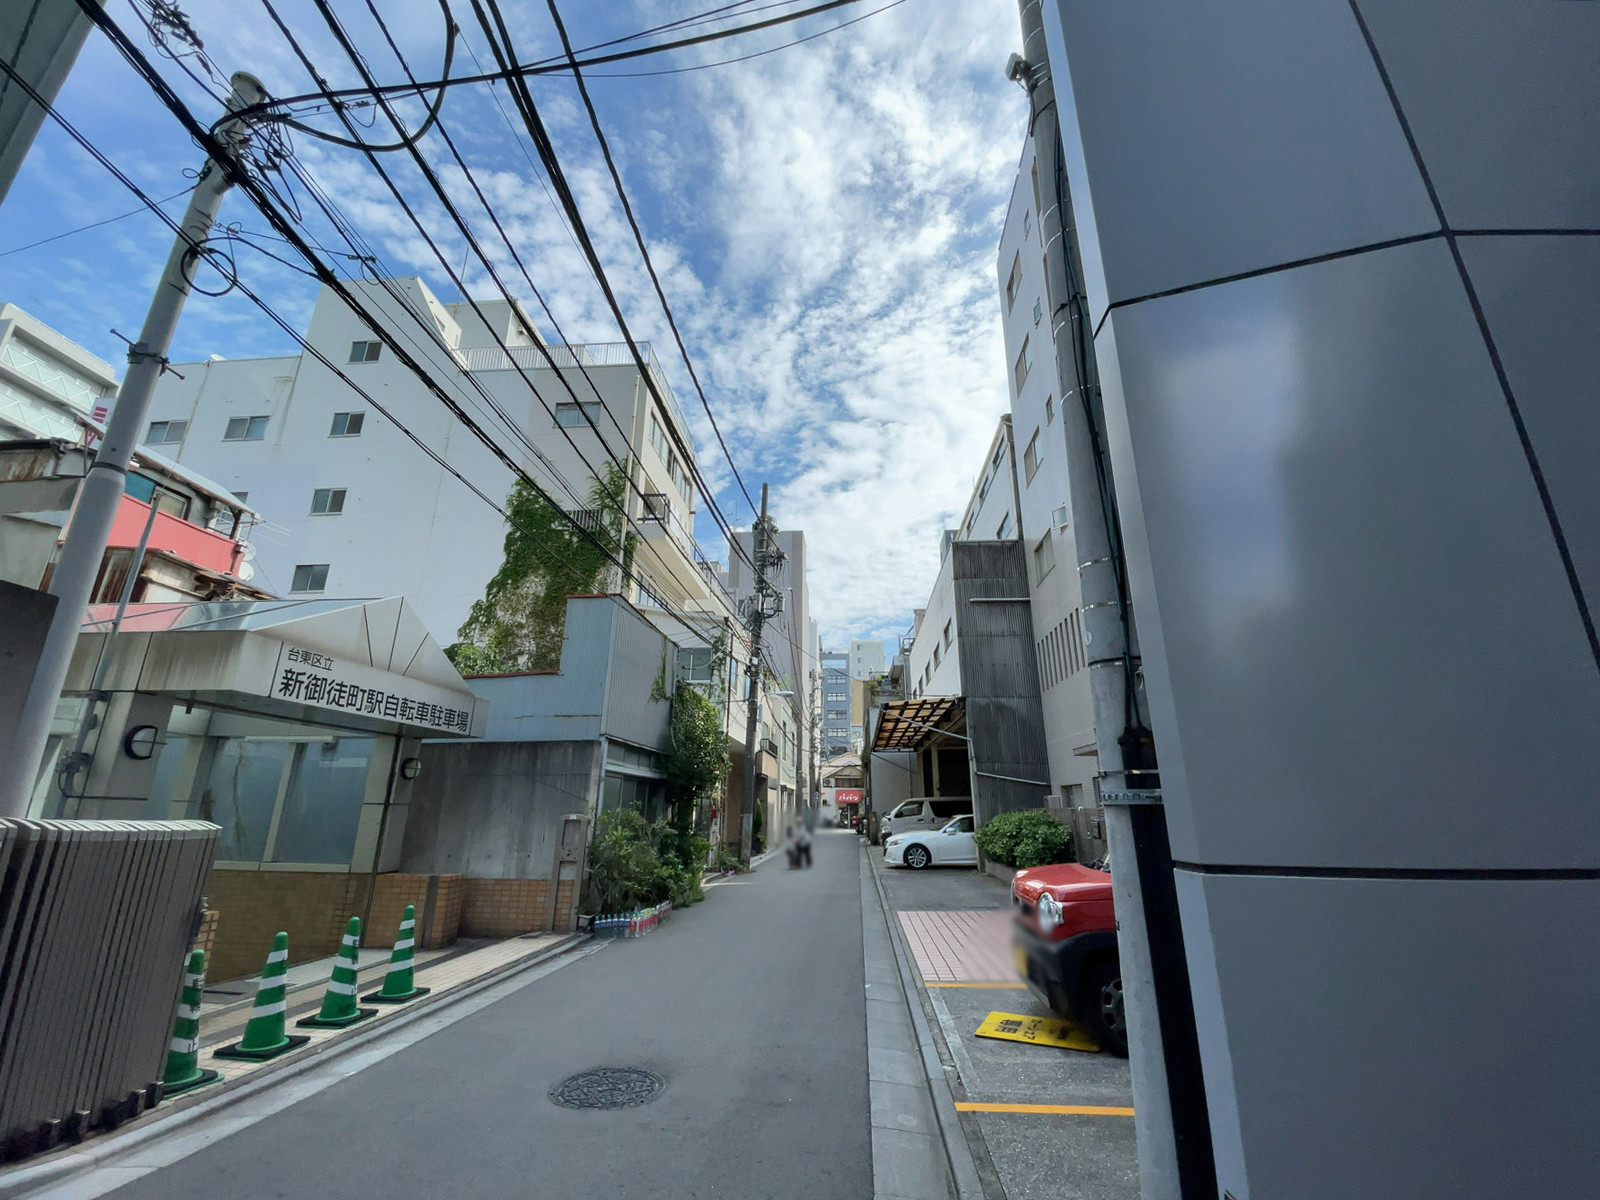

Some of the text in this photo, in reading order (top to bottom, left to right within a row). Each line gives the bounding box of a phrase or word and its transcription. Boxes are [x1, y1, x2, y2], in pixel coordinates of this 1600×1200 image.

[287, 647, 334, 671] 台東区立
[278, 667, 469, 732] 新御徒町駅自転車駐車場
